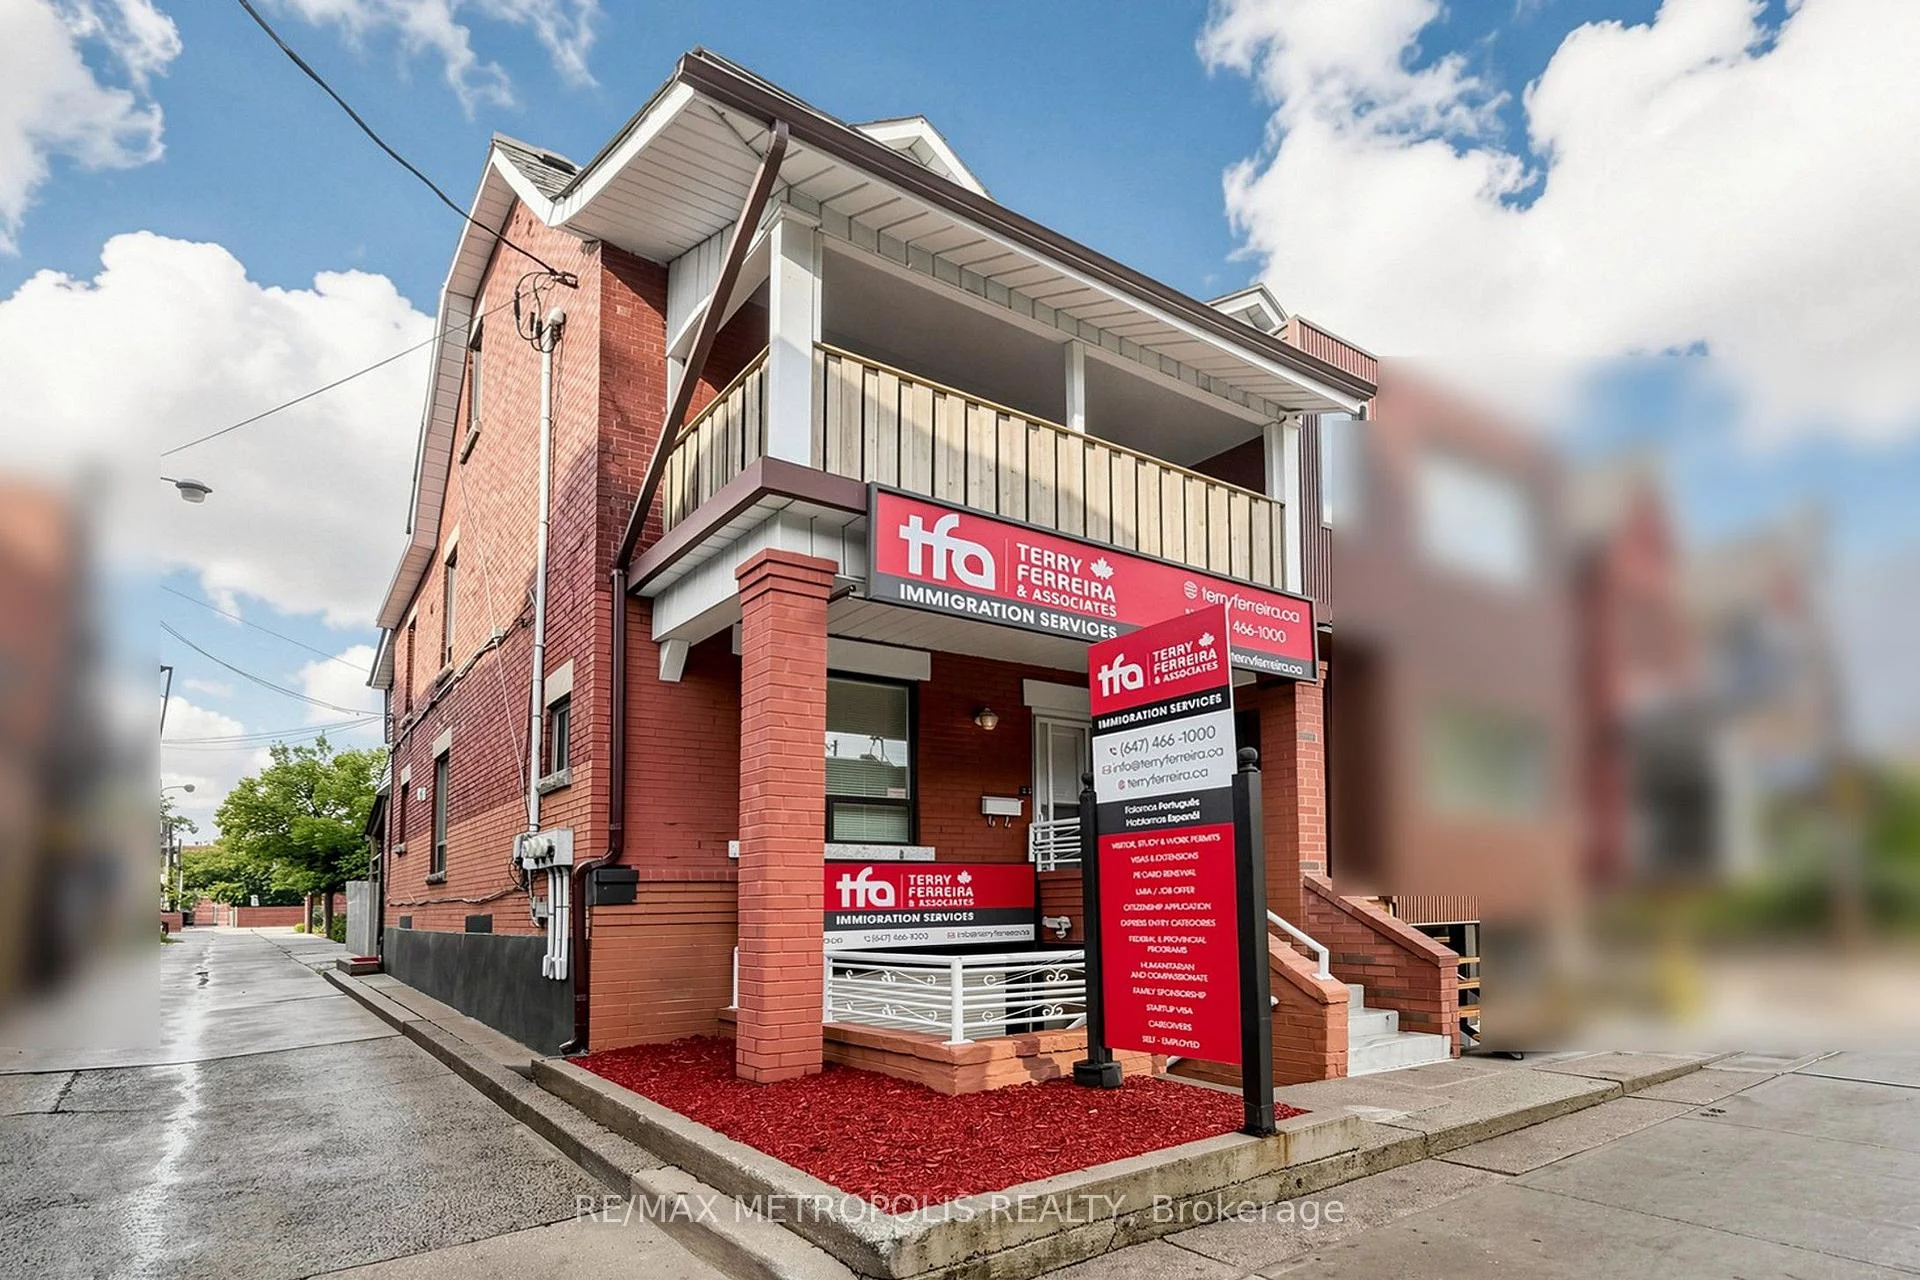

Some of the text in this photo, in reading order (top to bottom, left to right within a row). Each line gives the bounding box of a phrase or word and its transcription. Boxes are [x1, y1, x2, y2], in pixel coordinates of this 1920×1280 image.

[899, 513, 996, 591] tfa
[1016, 542, 1082, 574] TERRY
[1017, 565, 1117, 602] FERREIRA
[900, 584, 1118, 639] IMMIGRATION SERVICES
[1017, 585, 1117, 618] & ASSOCIATES
[1202, 587, 1300, 623] terryferreira.ca
[1233, 621, 1287, 643] 466-1000
[1152, 641, 1193, 662] TERRY
[1154, 648, 1217, 675] FERREIRA
[1097, 653, 1144, 697] tfa
[1154, 661, 1218, 685] & ASSOCIATES
[1098, 694, 1222, 730] IMMIGRATION SERVICES
[1120, 737, 1149, 757] (647)
[1113, 747, 1224, 773] info@terryferreira.ca
[1127, 768, 1208, 788] terryferreira.ca
[1126, 815, 1166, 827] Hablamos
[1166, 835, 1190, 845] WORK
[1190, 833, 1221, 843] PERMITS
[836, 866, 895, 908] tfa
[908, 874, 952, 886] TERRY
[1158, 886, 1172, 895] JOB
[1172, 886, 1195, 894] OFFER
[908, 886, 974, 898] FERREIRA
[919, 898, 974, 907] ASSOCIATES
[1164, 902, 1211, 911] APPLICATION
[836, 912, 974, 925] IMMIGRATION SERVICES
[1130, 971, 1147, 979] AND
[1176, 1006, 1193, 1015] VISA
